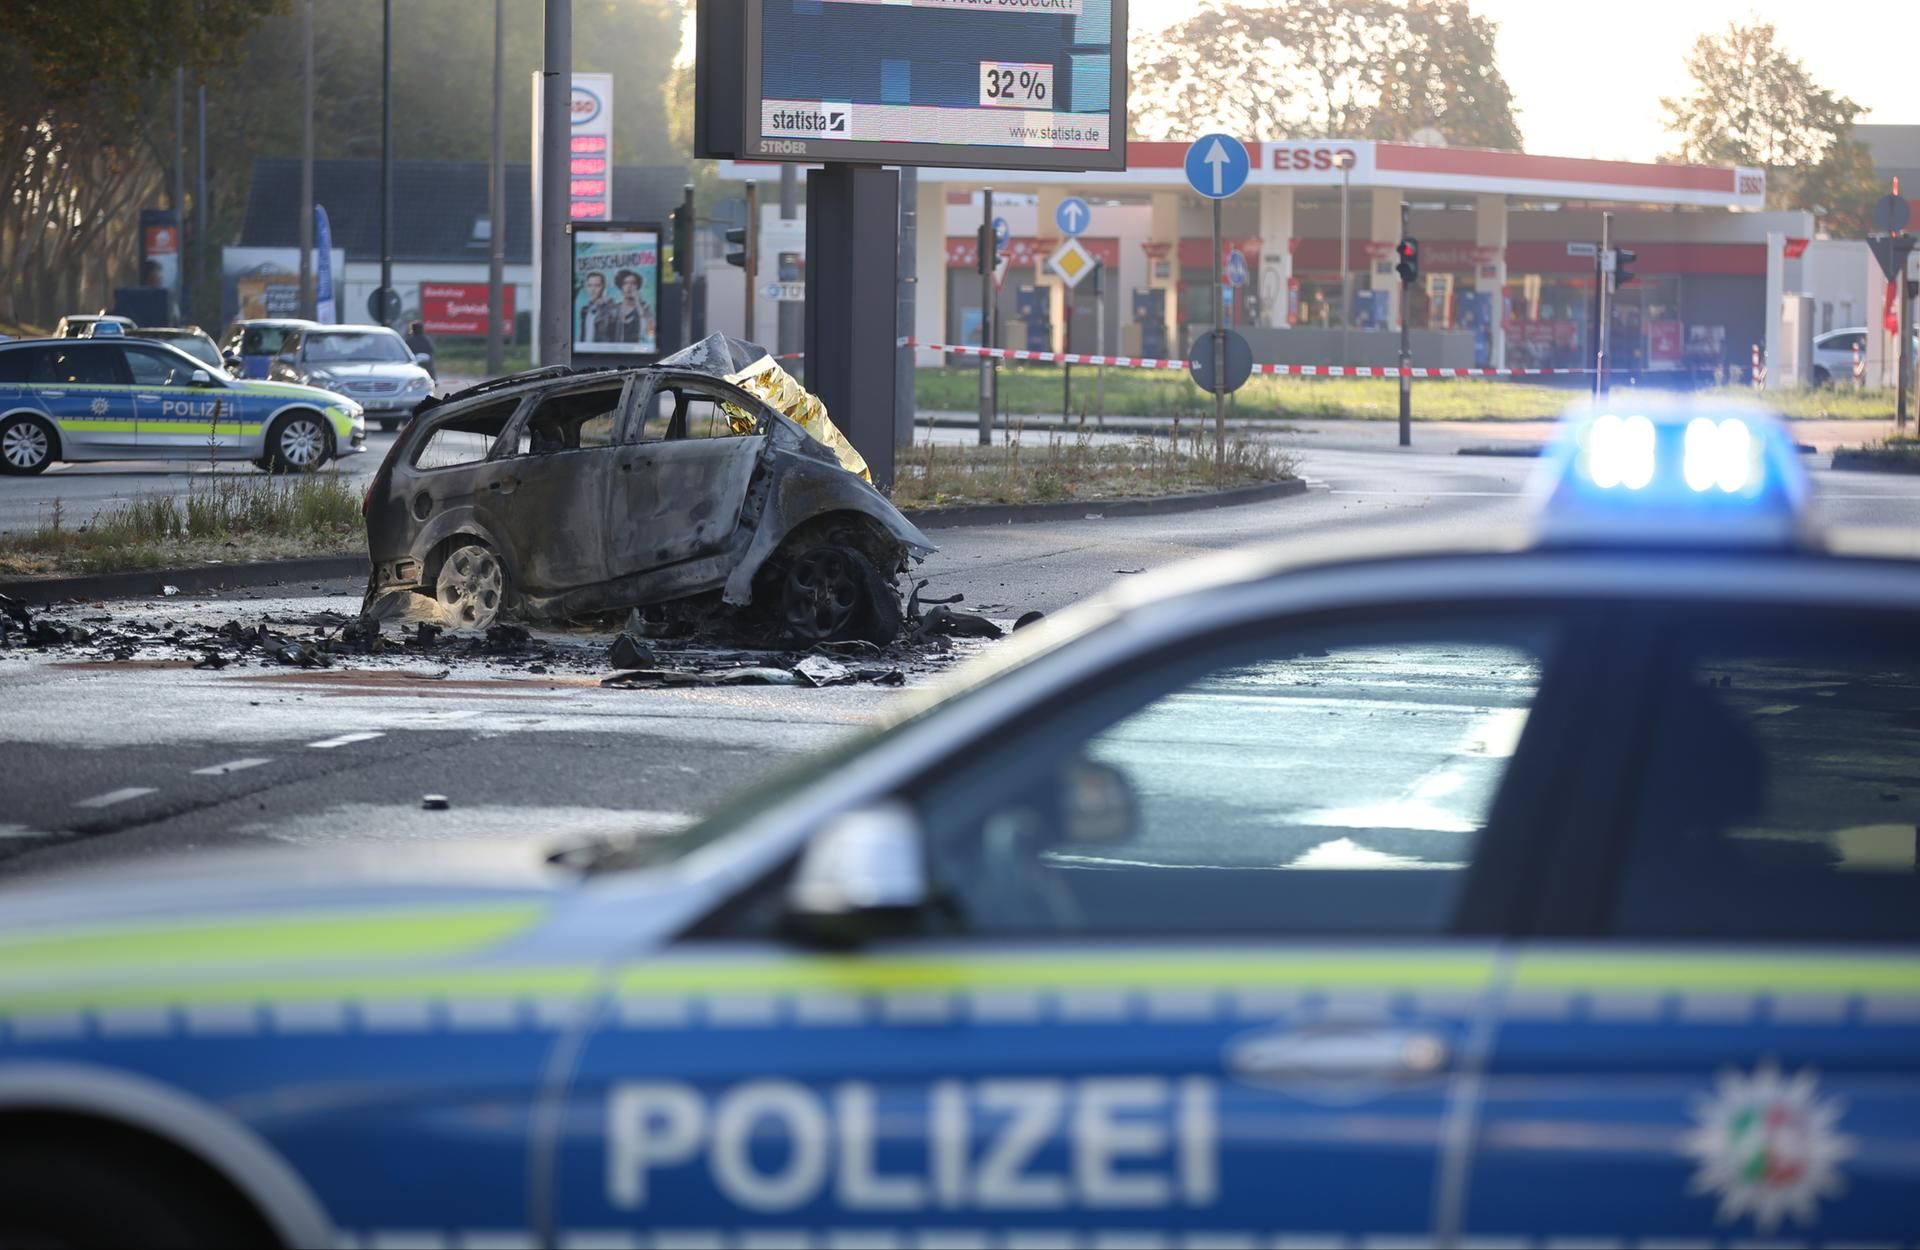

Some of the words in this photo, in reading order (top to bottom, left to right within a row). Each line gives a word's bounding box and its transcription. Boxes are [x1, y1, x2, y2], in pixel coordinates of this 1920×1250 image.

[772, 110, 827, 131] statista
[1009, 126, 1100, 142] www.statista.de
[760, 140, 807, 154] STRÖER
[1273, 148, 1357, 171] ESSO
[1740, 175, 1763, 194] ESSO
[162, 401, 234, 417] POLIZEI
[607, 1078, 1219, 1211] POLIZEI
